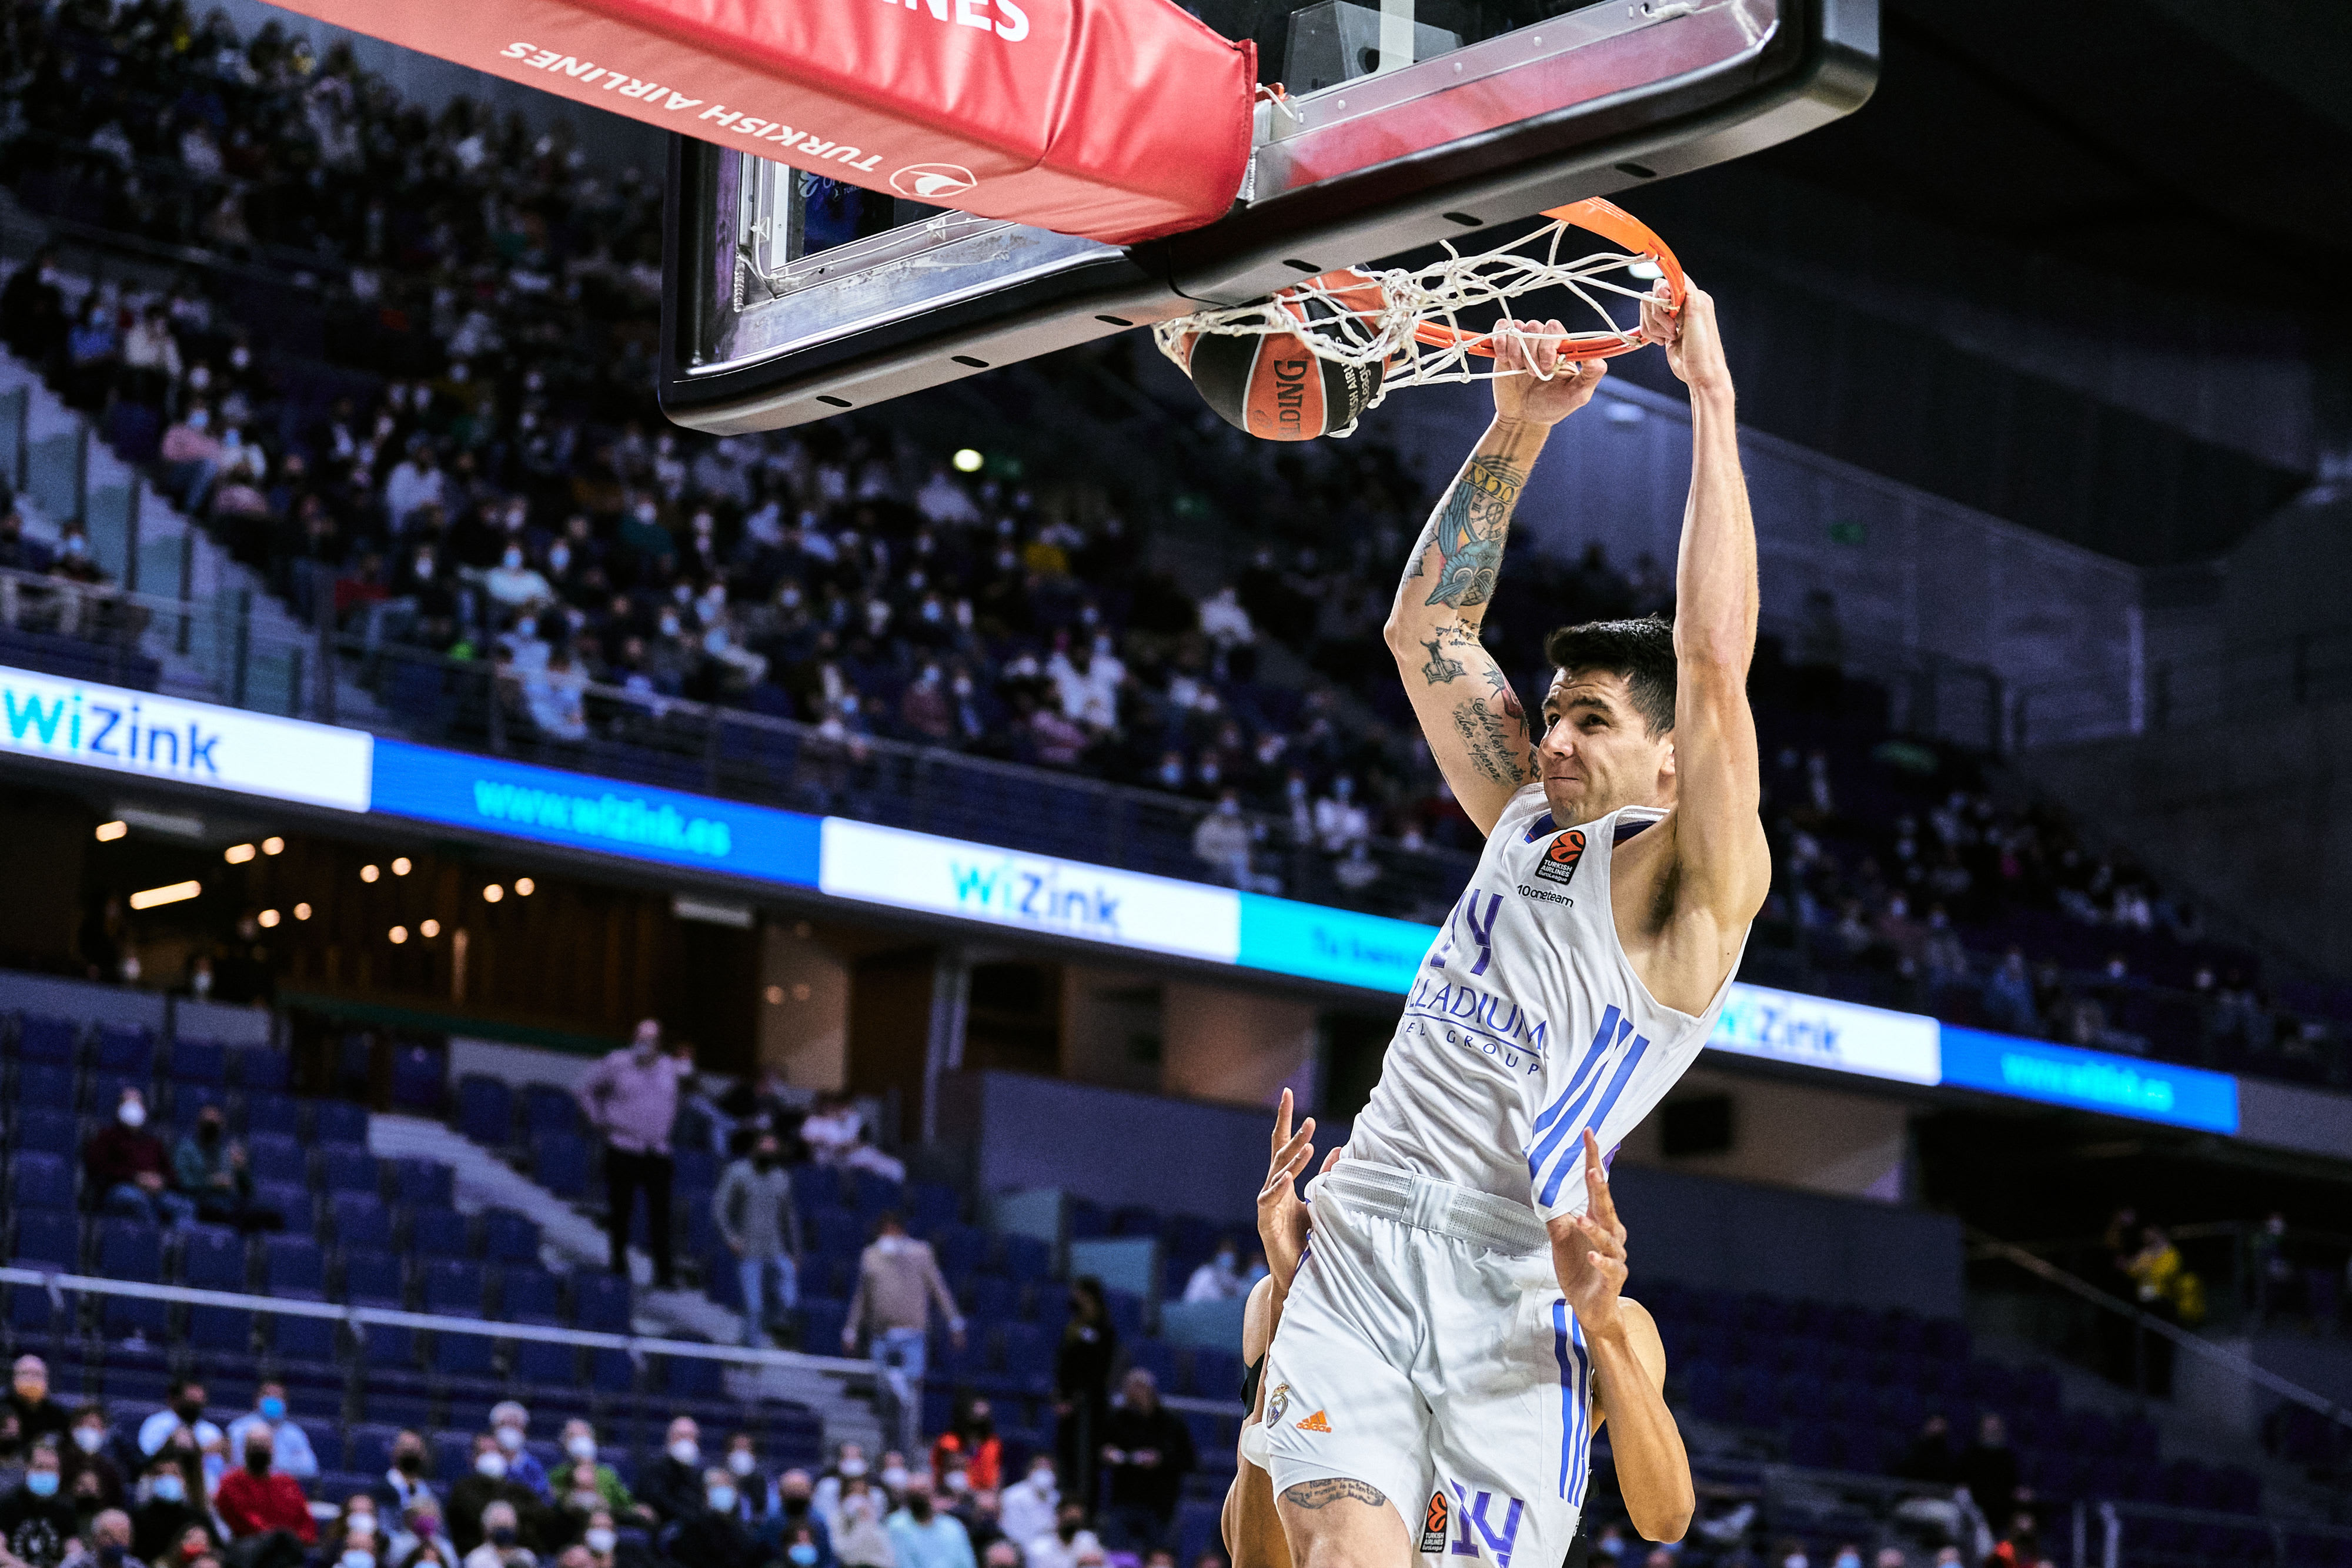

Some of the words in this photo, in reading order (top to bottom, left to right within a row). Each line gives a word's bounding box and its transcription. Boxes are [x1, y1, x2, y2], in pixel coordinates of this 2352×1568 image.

[500, 42, 704, 111] AIRLINES
[698, 105, 883, 172] TURKISH
[4, 688, 219, 773] WiZink
[948, 858, 1122, 928] WiZink
[1538, 870, 1568, 882] EuroLeague
[1540, 865, 1571, 878] AIRLINES
[1544, 859, 1573, 872] TURKISH
[1446, 1029, 1539, 1076] GROUP
[1296, 1422, 1332, 1433] adidas
[1450, 1477, 1525, 1568] 14
